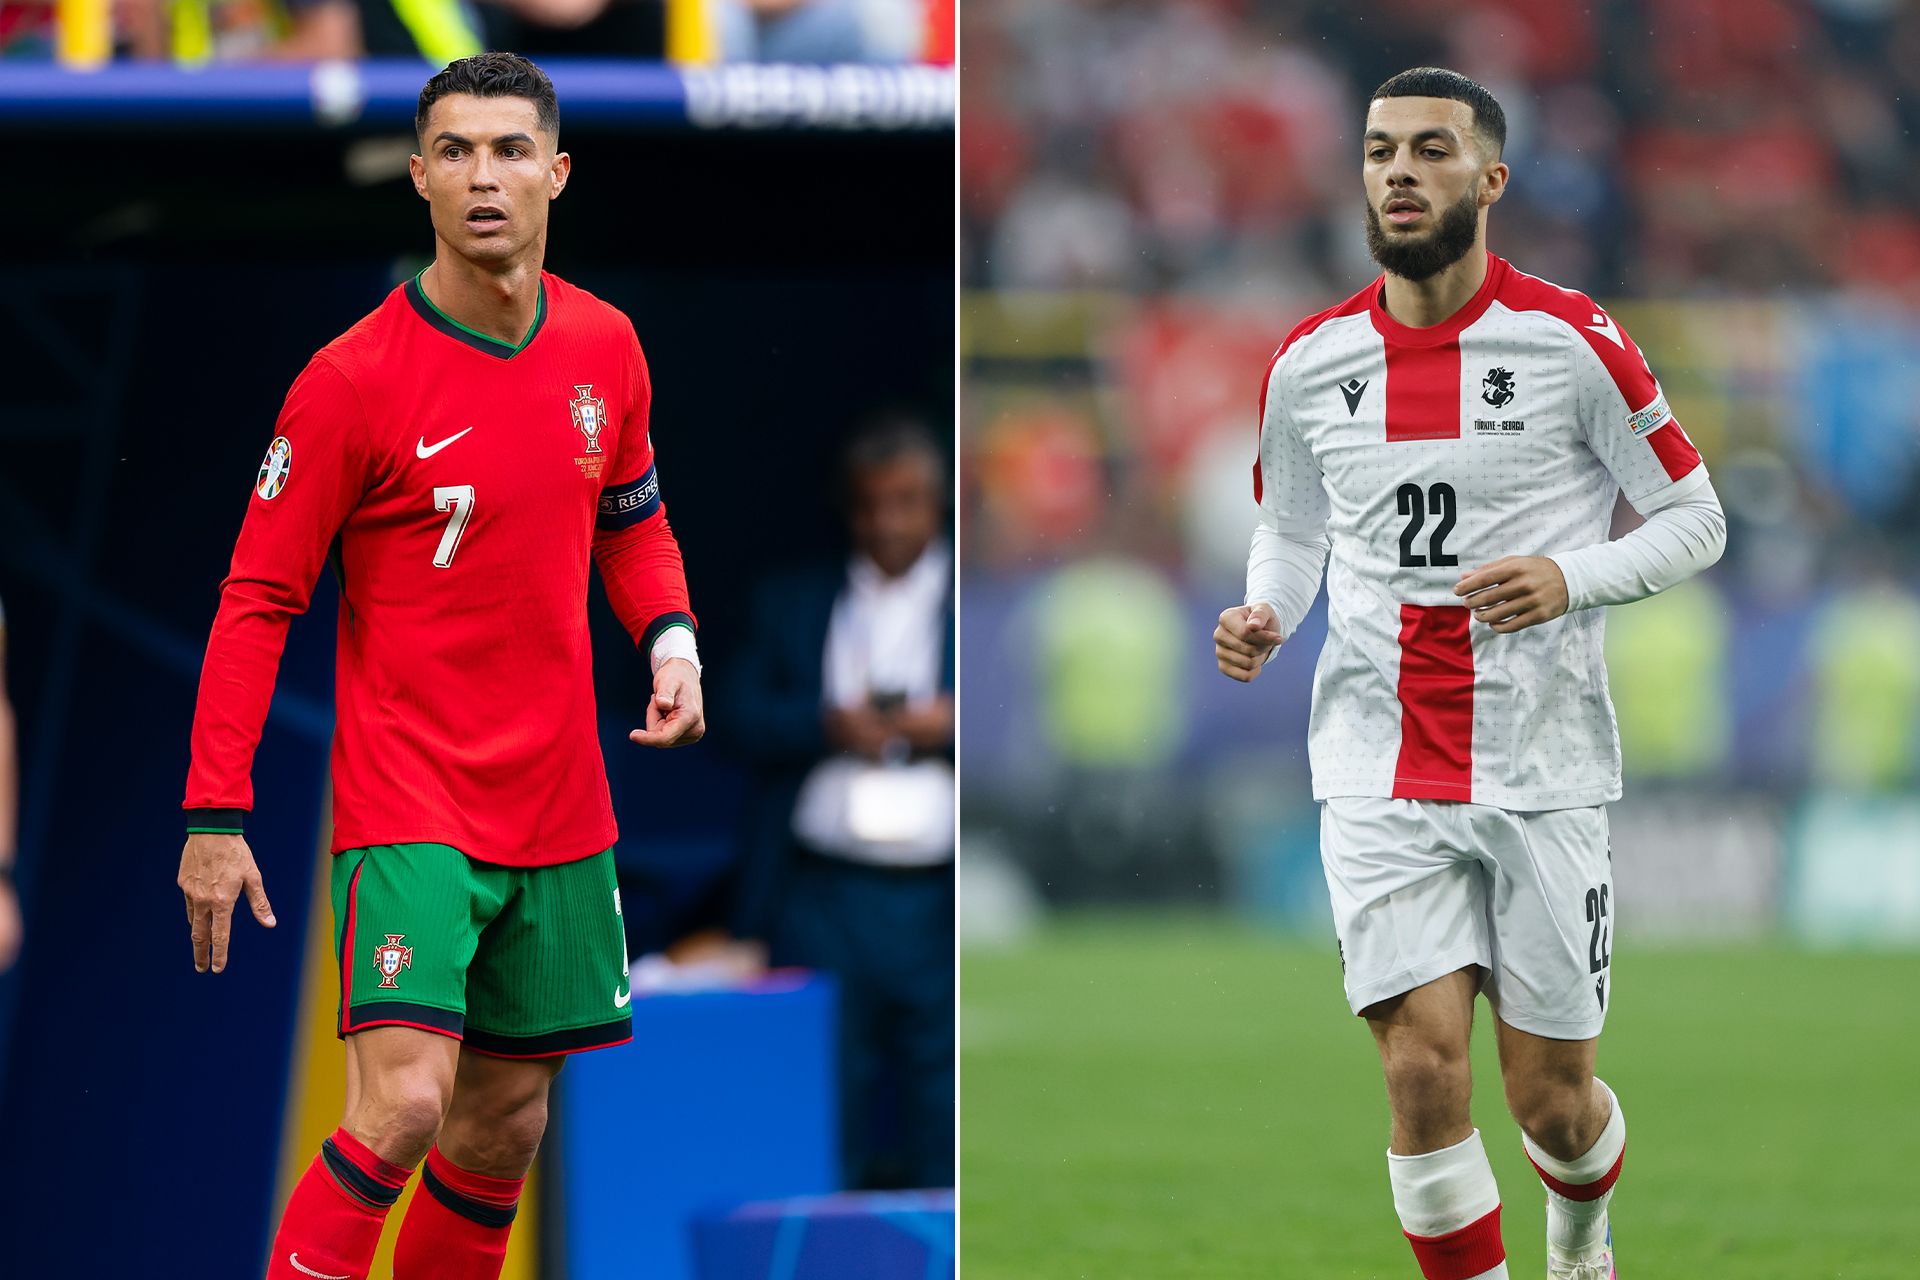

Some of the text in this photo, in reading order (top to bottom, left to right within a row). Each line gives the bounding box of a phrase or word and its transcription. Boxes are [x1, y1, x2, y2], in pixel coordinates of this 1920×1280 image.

[1501, 420, 1525, 431] GEORGIA
[432, 485, 475, 568] 7
[618, 473, 658, 509] RESPEC
[1396, 482, 1458, 567] 22
[1585, 883, 1609, 974] 22
